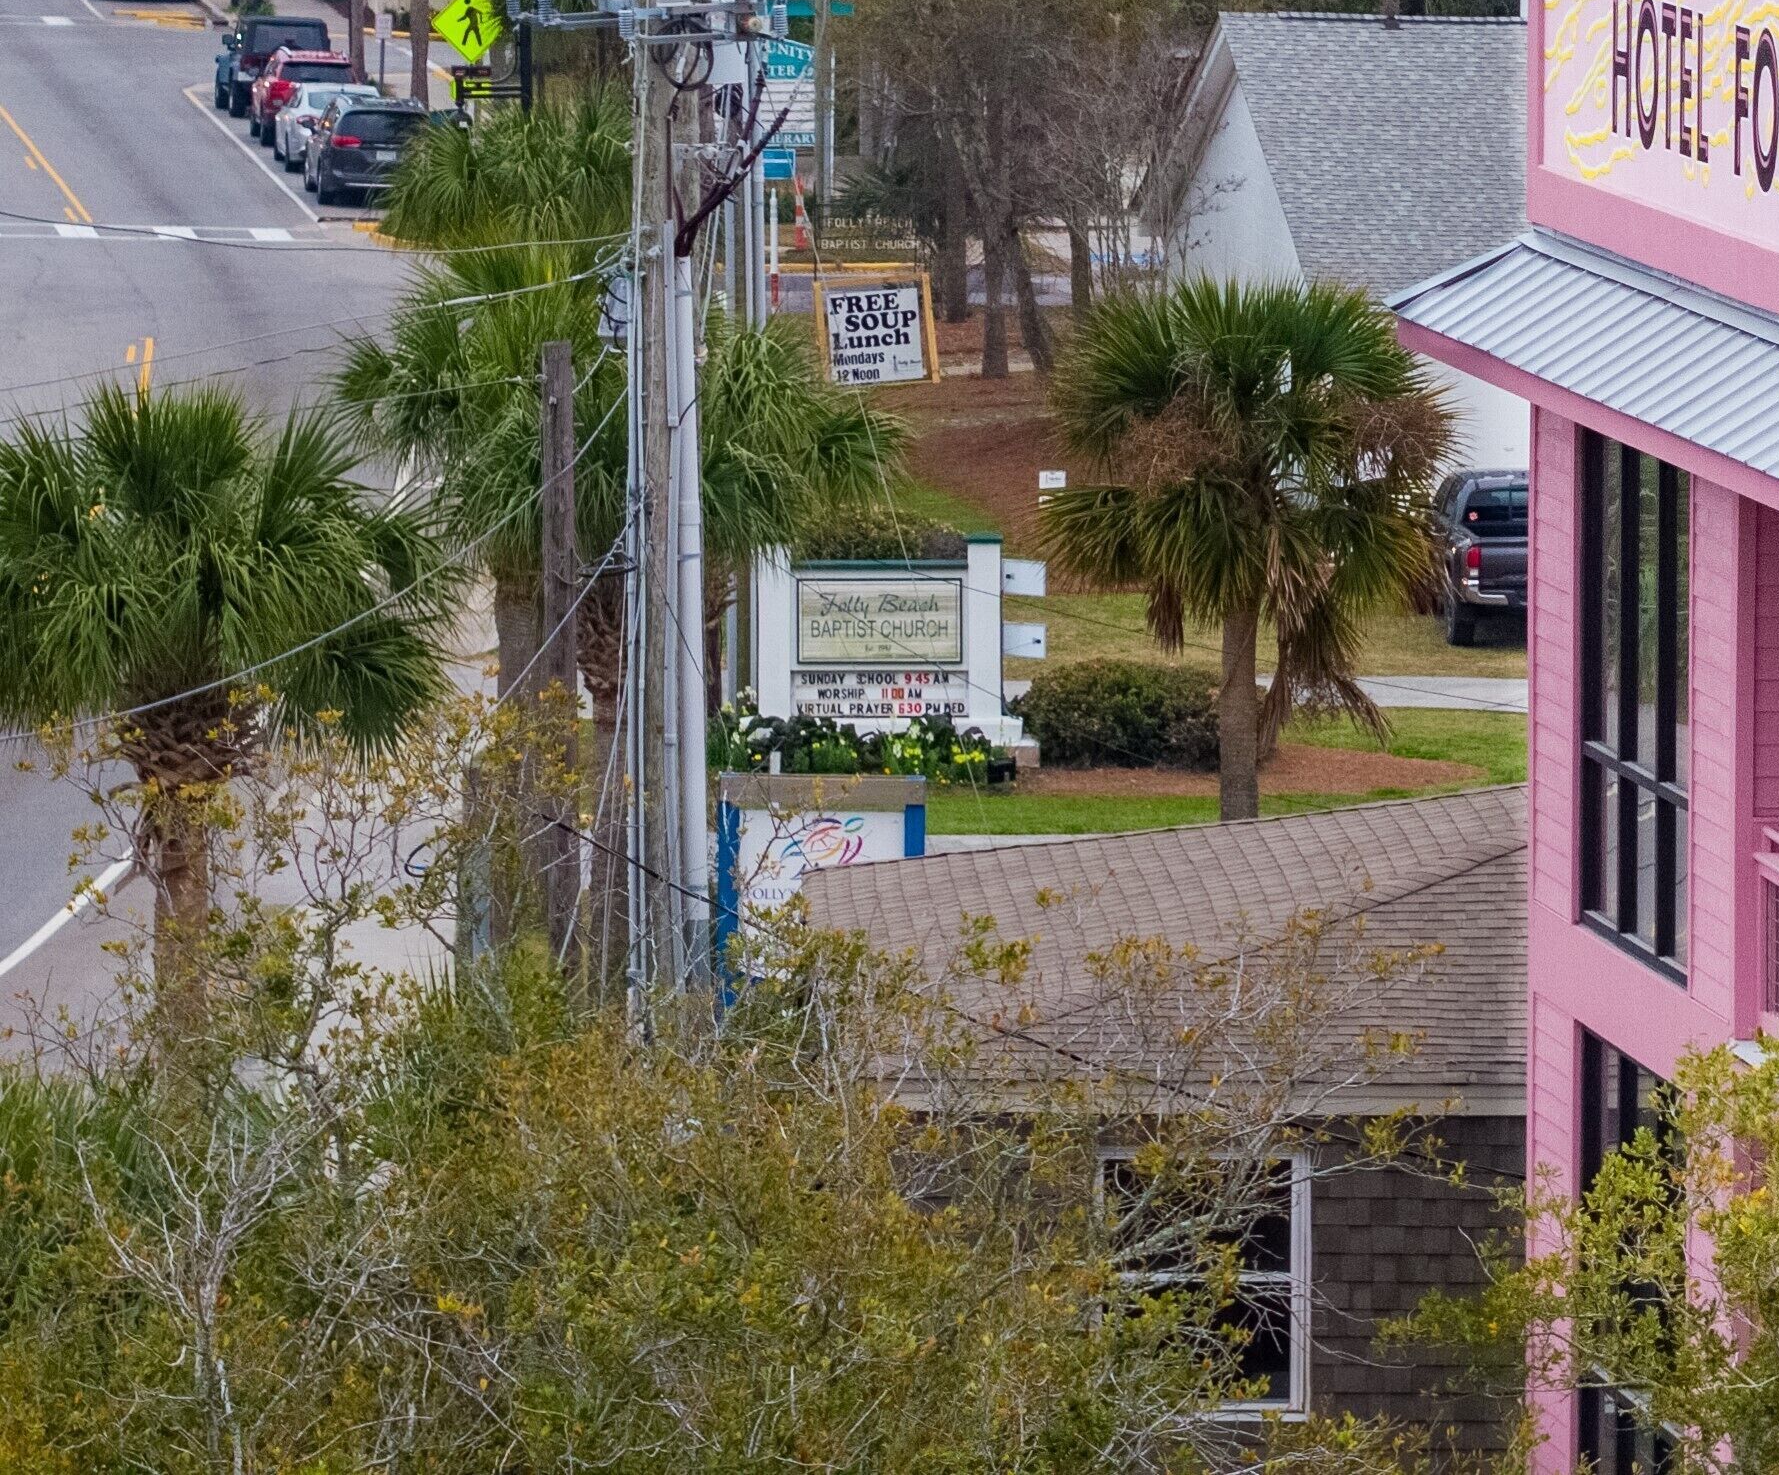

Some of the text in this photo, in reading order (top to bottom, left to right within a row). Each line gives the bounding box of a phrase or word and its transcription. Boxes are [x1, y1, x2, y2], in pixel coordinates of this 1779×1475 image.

[827, 216, 864, 228] FOLLY
[820, 239, 921, 250] BAPTIST CHURCH
[830, 292, 899, 315] FREE
[845, 310, 917, 332] SOUP
[832, 328, 911, 350] Lunch
[833, 352, 885, 366] Mondays
[836, 368, 880, 382] 12 Noon
[820, 593, 940, 619] Folly Beach
[811, 620, 949, 638] BAPTIST CHURCH
[801, 674, 846, 685] SUNDAY
[856, 674, 898, 685] SCHOOL
[933, 673, 950, 685] AM
[818, 689, 865, 699] WORSHIP
[907, 688, 922, 699] AM
[797, 703, 844, 714] VIRTUAL
[850, 703, 893, 714] PRAYER
